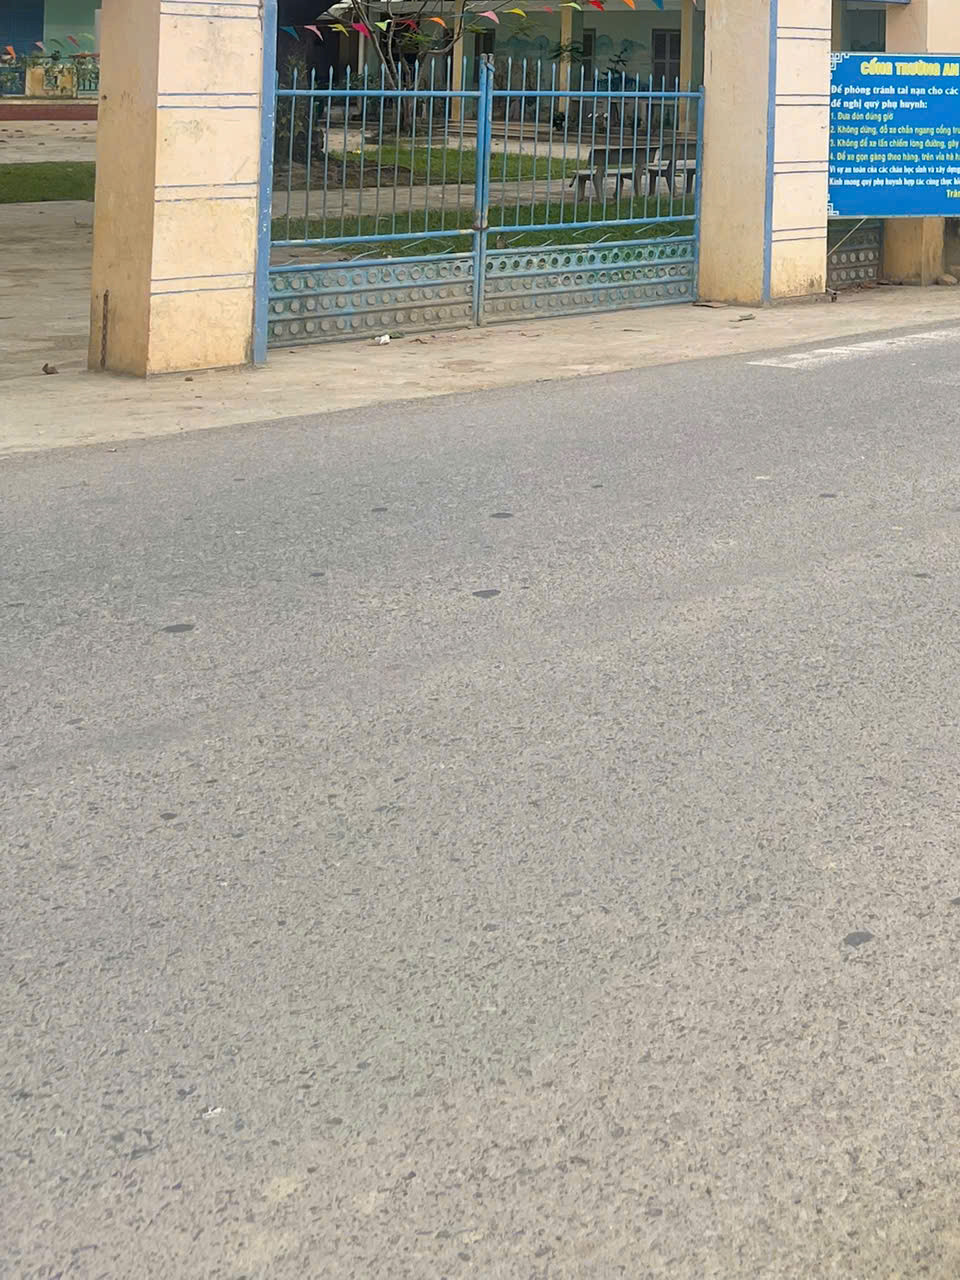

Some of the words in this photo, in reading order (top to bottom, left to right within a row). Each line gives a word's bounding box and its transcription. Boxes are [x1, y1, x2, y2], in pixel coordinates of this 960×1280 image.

[860, 57, 893, 76] CỔNG
[894, 60, 940, 76] TRƯỜNG
[942, 62, 960, 76] AN
[872, 86, 895, 94] tránh
[898, 86, 908, 94] tai
[910, 88, 926, 96] nạn
[927, 86, 943, 95] cho
[945, 86, 958, 95] các
[881, 99, 898, 110] phụ
[900, 99, 927, 110] huynh:
[837, 125, 858, 136] Không
[837, 138, 858, 149] Không
